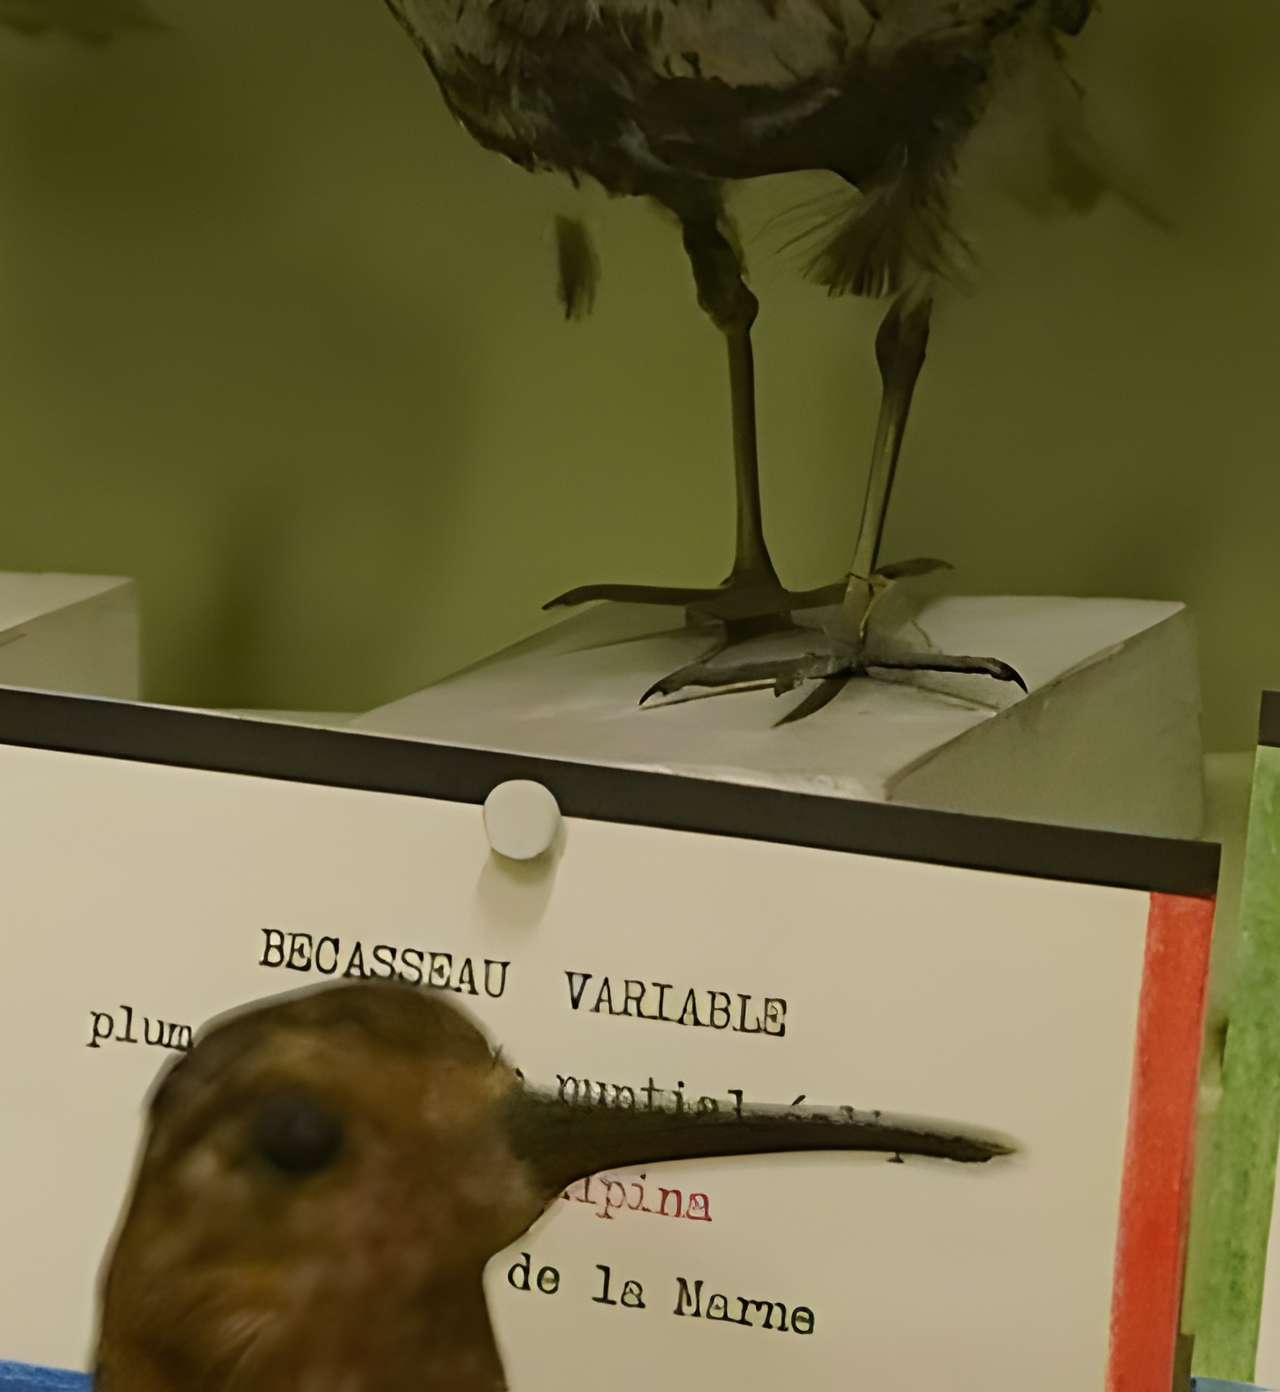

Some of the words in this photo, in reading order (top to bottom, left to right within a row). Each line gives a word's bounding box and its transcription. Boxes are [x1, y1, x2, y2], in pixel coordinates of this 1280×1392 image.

[259, 928, 511, 999] BECASSEAU
[564, 971, 788, 1038] VARIABLE
[558, 1170, 713, 1223] lpina
[506, 1251, 561, 1296] de
[591, 1264, 647, 1312] la
[672, 1277, 816, 1337] Marne
